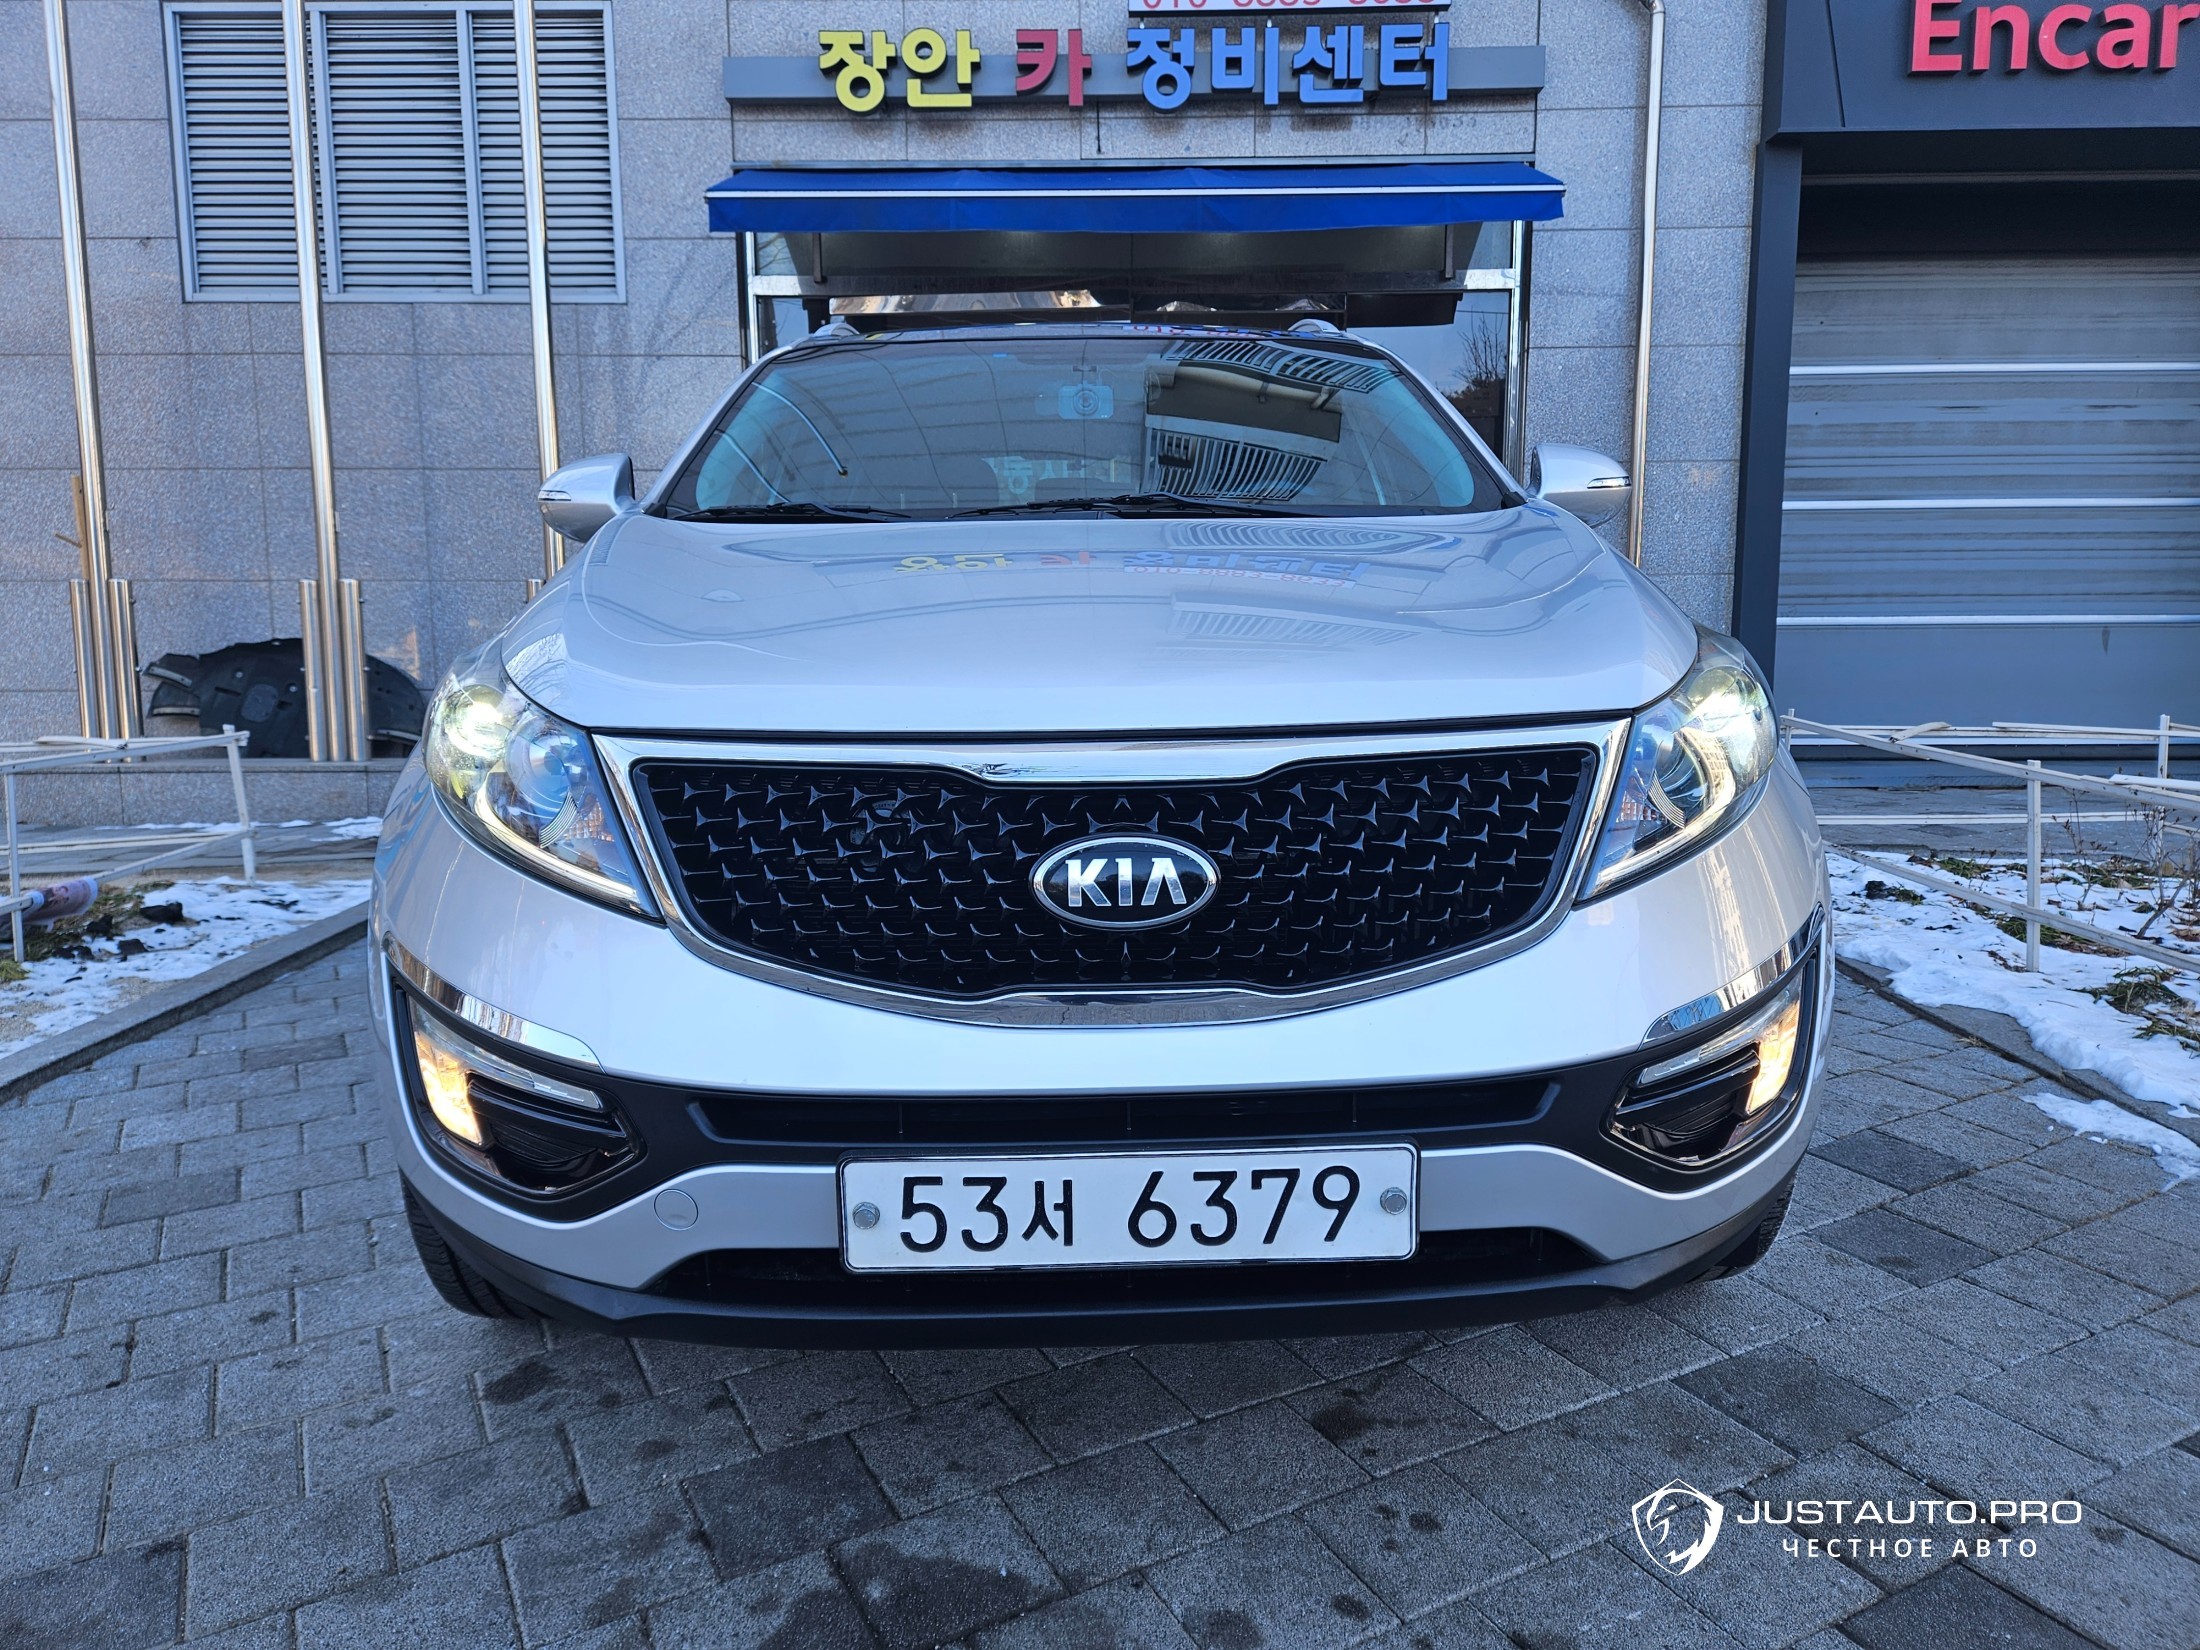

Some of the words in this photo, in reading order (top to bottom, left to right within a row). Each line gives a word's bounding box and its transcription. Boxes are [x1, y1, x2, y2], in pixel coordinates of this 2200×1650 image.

[818, 27, 981, 114] 장안
[1015, 28, 1093, 109] 카
[1126, 22, 1450, 112] 정비센터
[1911, 0, 2200, 73] Encar
[1064, 857, 1188, 907] KIA
[899, 1175, 1074, 1253] 53서
[1126, 1165, 1362, 1249] 6379
